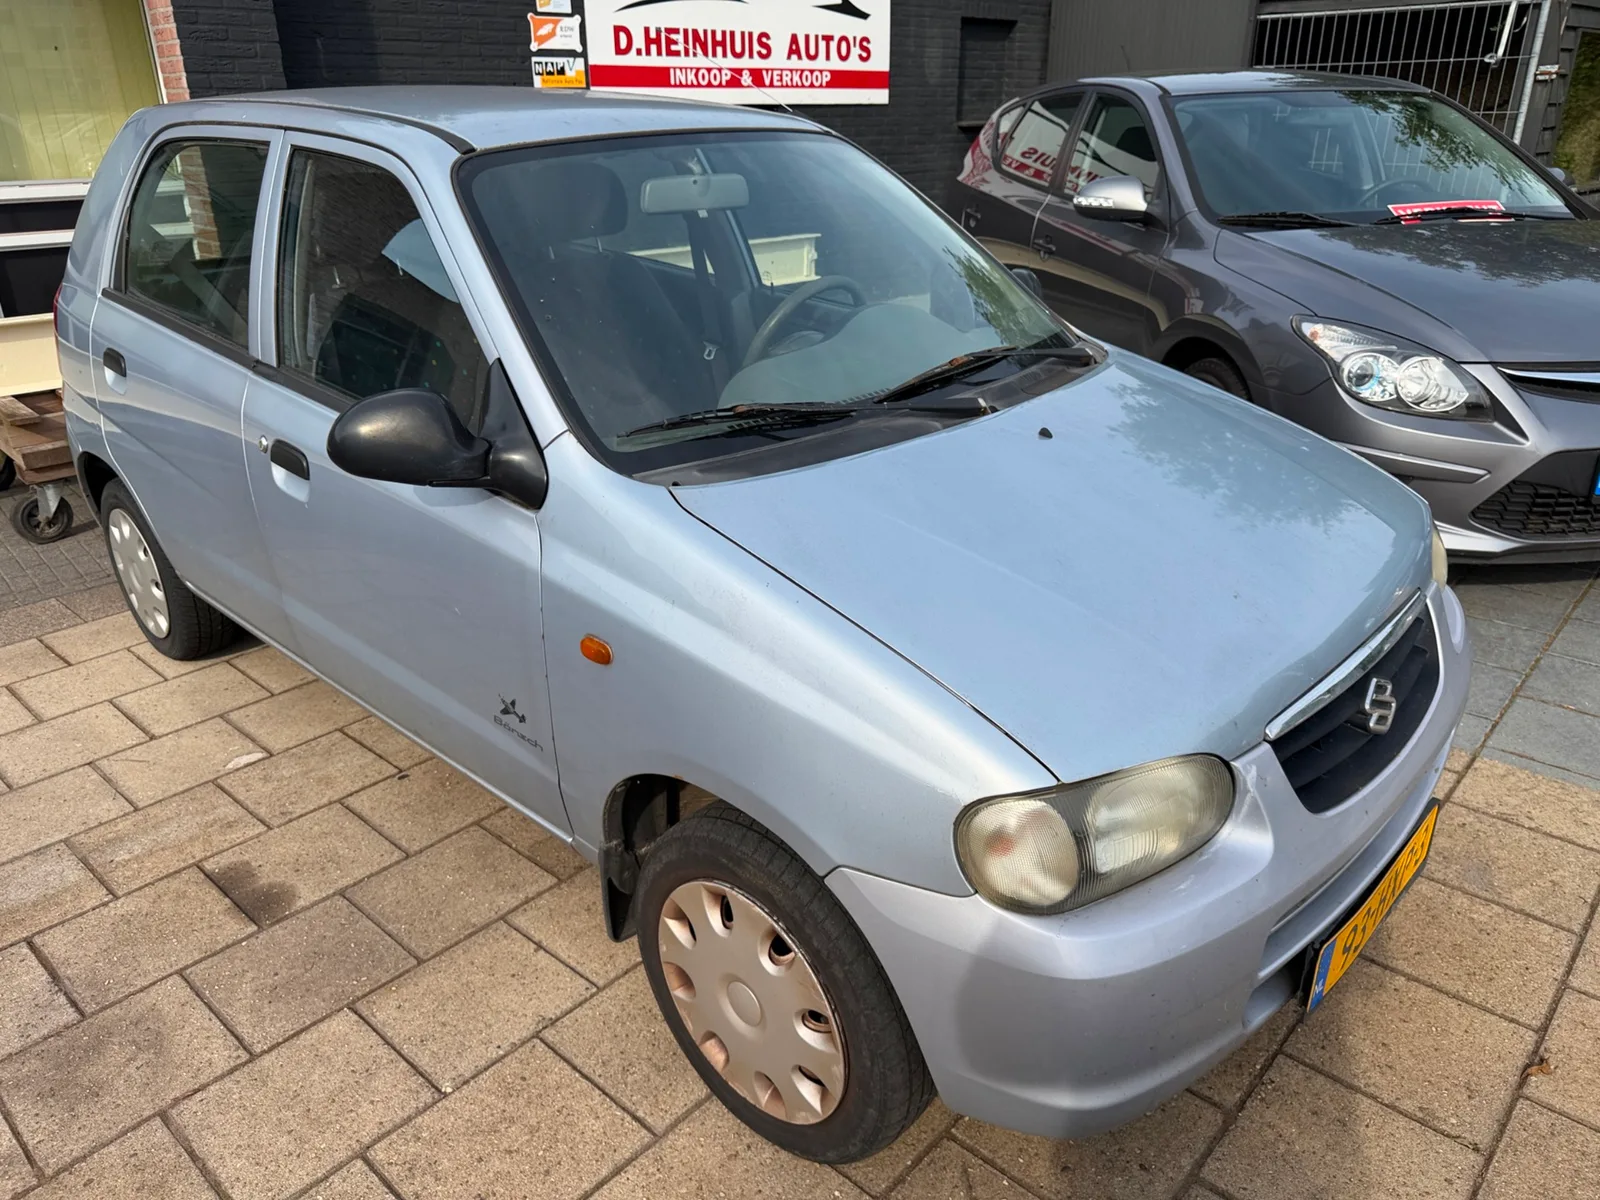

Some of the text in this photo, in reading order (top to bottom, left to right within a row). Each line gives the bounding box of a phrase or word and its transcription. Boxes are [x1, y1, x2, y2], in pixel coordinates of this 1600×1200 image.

[613, 25, 871, 62] D.HEINHUIS AUTO'S
[669, 67, 831, 87] INKOOP & VERKOOP
